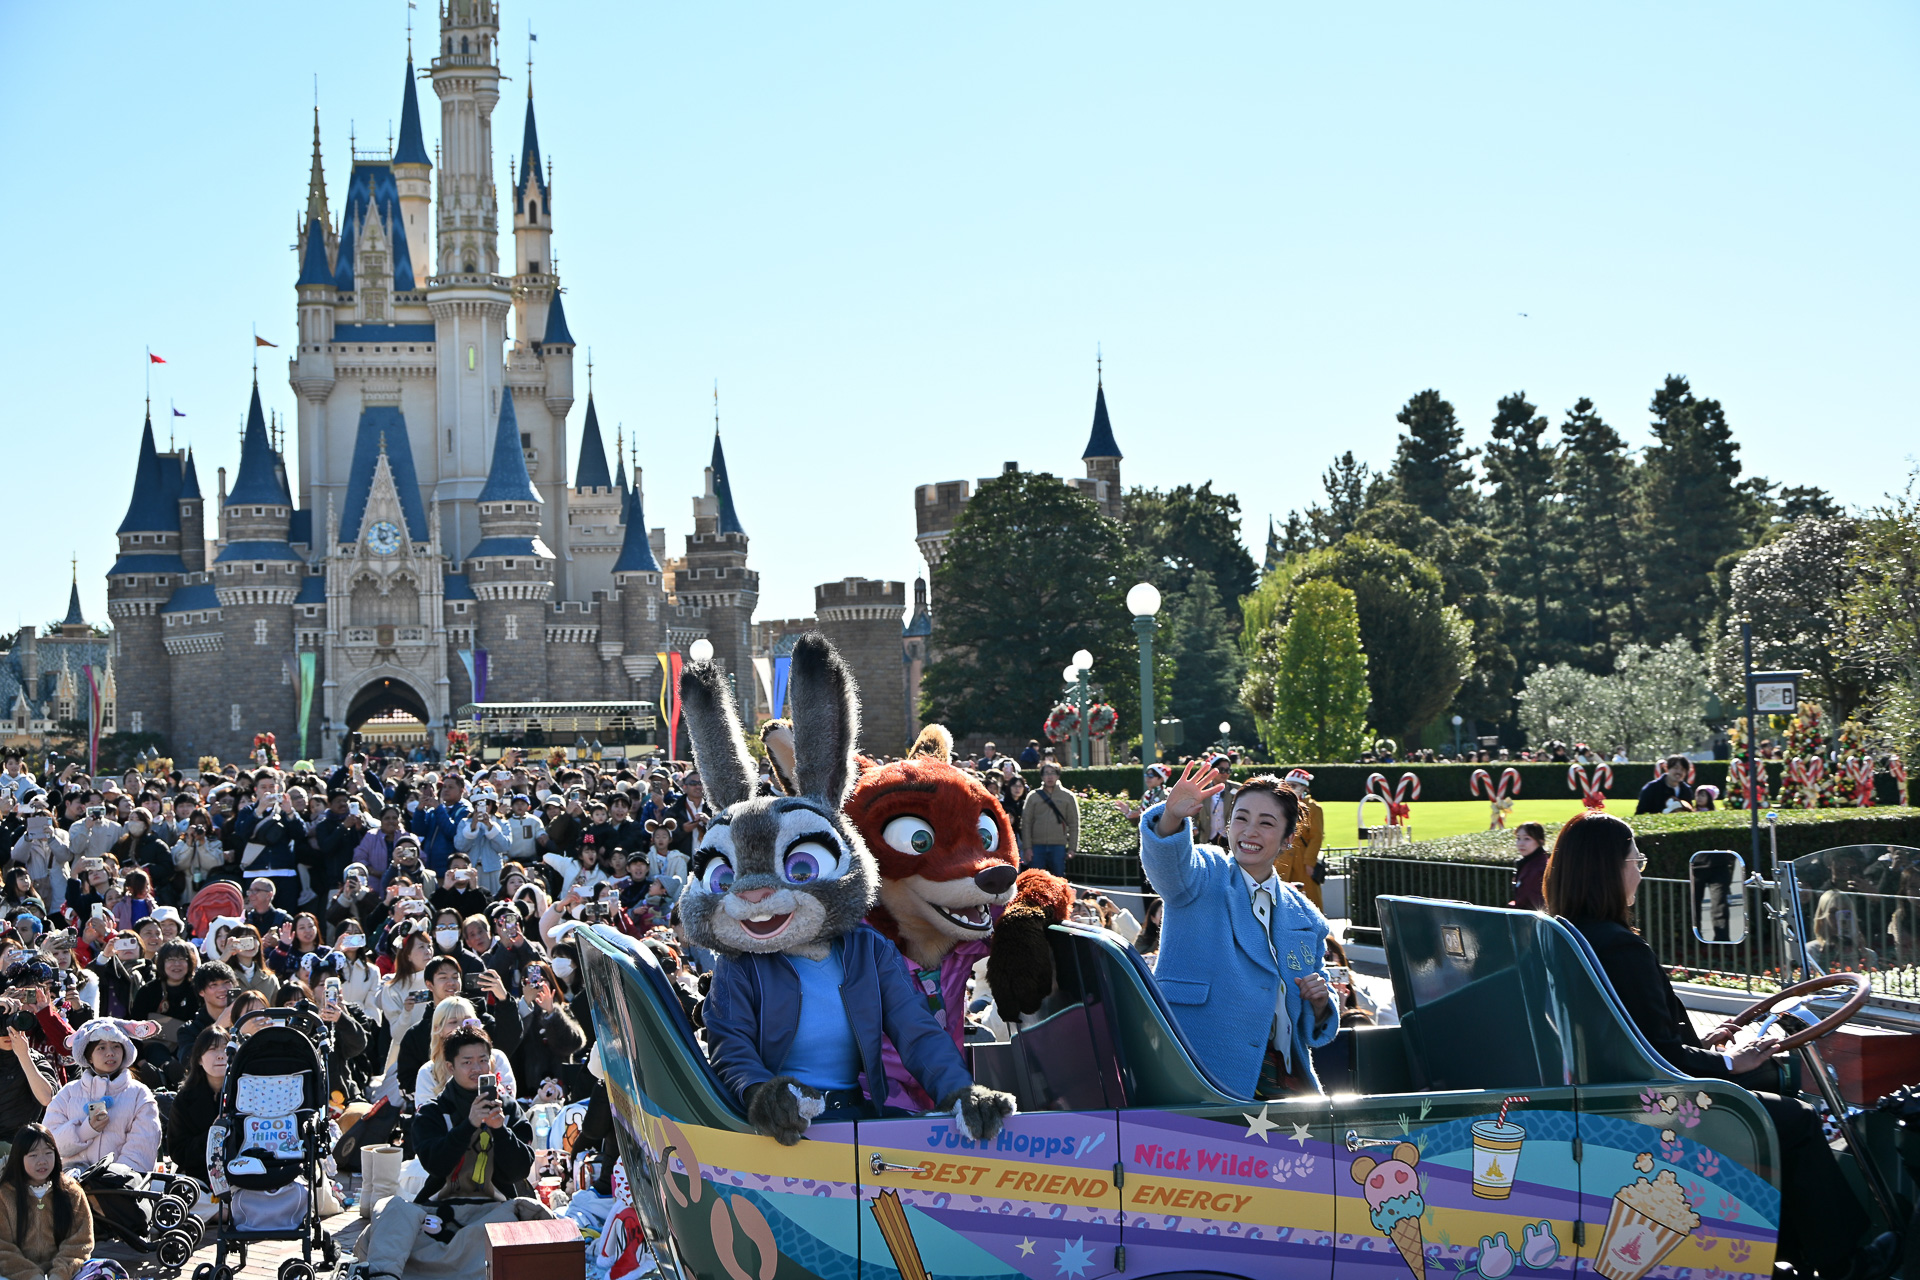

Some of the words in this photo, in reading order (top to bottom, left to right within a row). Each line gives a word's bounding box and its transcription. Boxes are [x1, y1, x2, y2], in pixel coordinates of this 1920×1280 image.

[251, 1120, 292, 1131] GOOD
[996, 1128, 1076, 1159] Hopps
[1134, 1143, 1192, 1171] Nick
[1197, 1148, 1270, 1179] Wilde
[911, 1160, 991, 1186] BEST
[995, 1169, 1109, 1198] FRIEND
[1131, 1184, 1253, 1213] ENERGY
